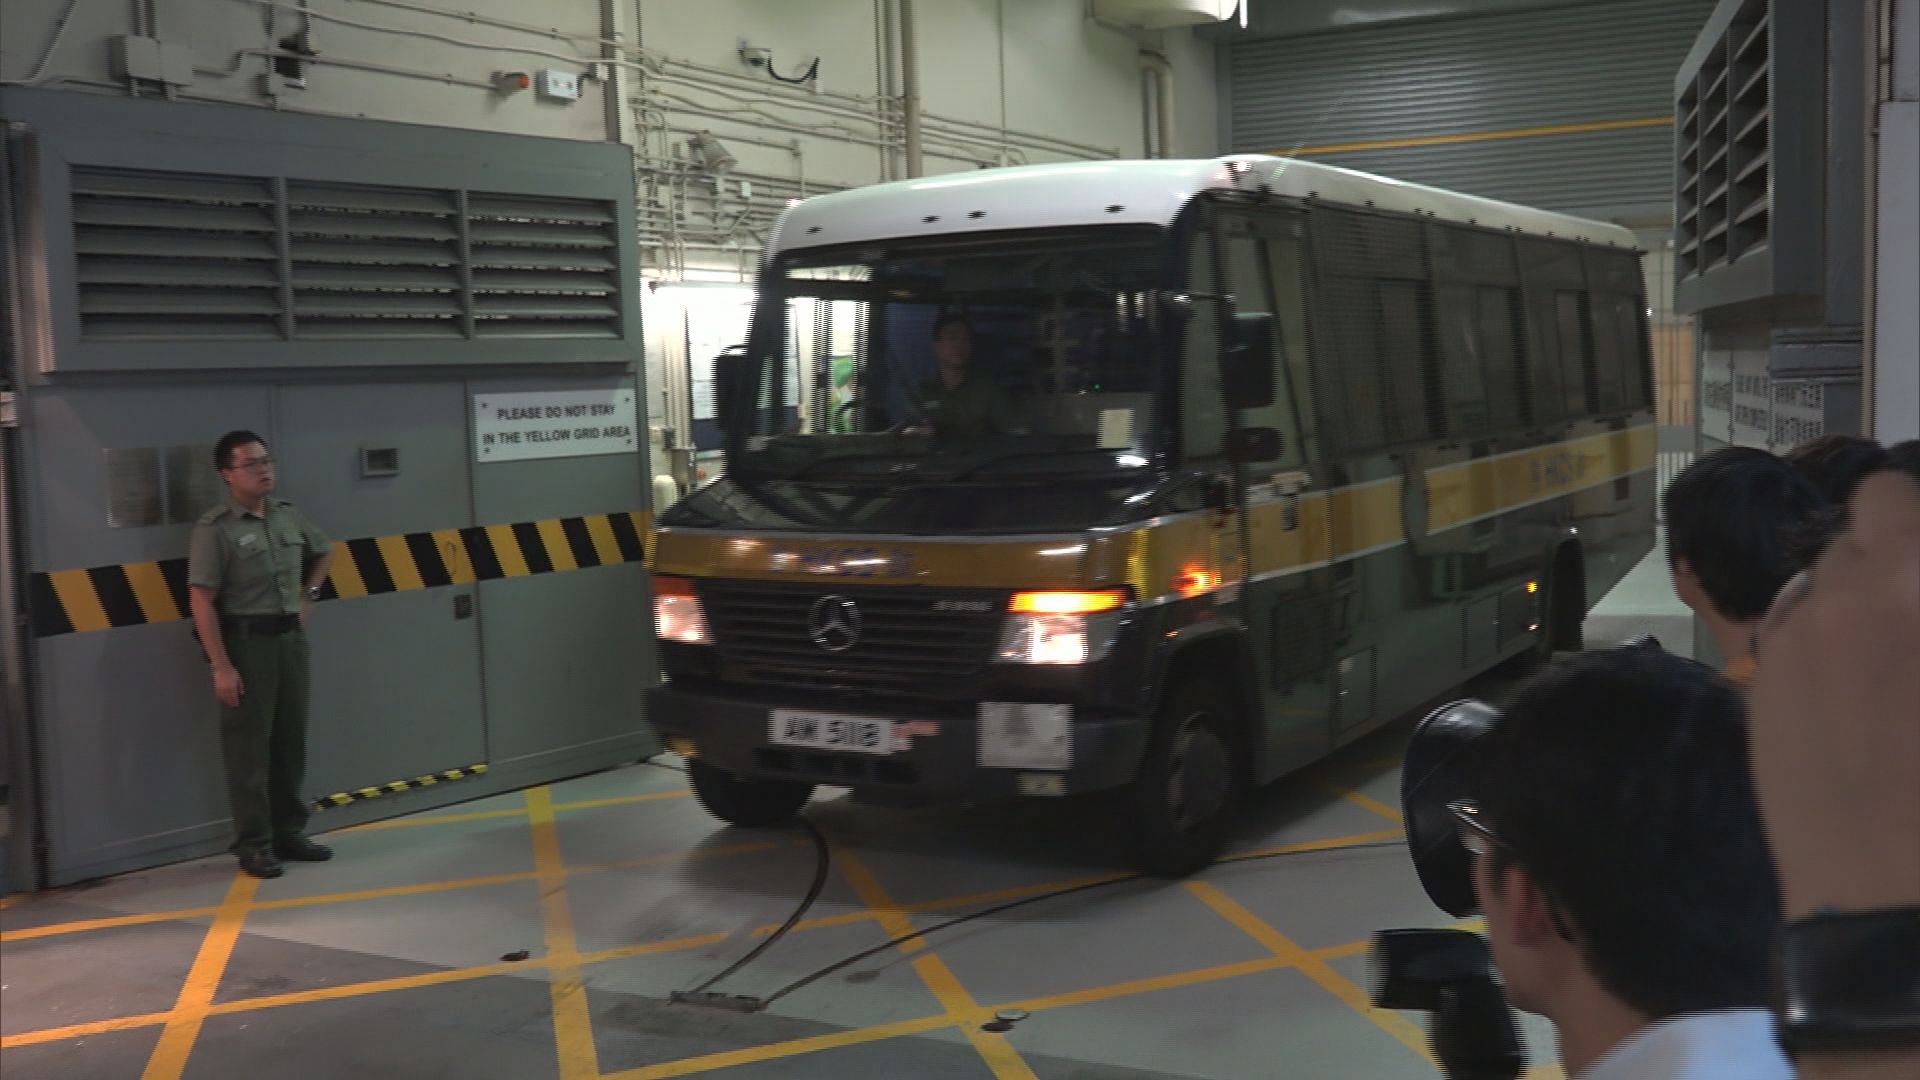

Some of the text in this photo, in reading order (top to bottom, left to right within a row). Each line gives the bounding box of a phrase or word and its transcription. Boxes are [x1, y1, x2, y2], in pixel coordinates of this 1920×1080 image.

[496, 404, 616, 422] PLEASE DO NOT STAY
[482, 425, 631, 446] IN THE YELLOW GRID AREA
[783, 717, 881, 748] AM 5118
